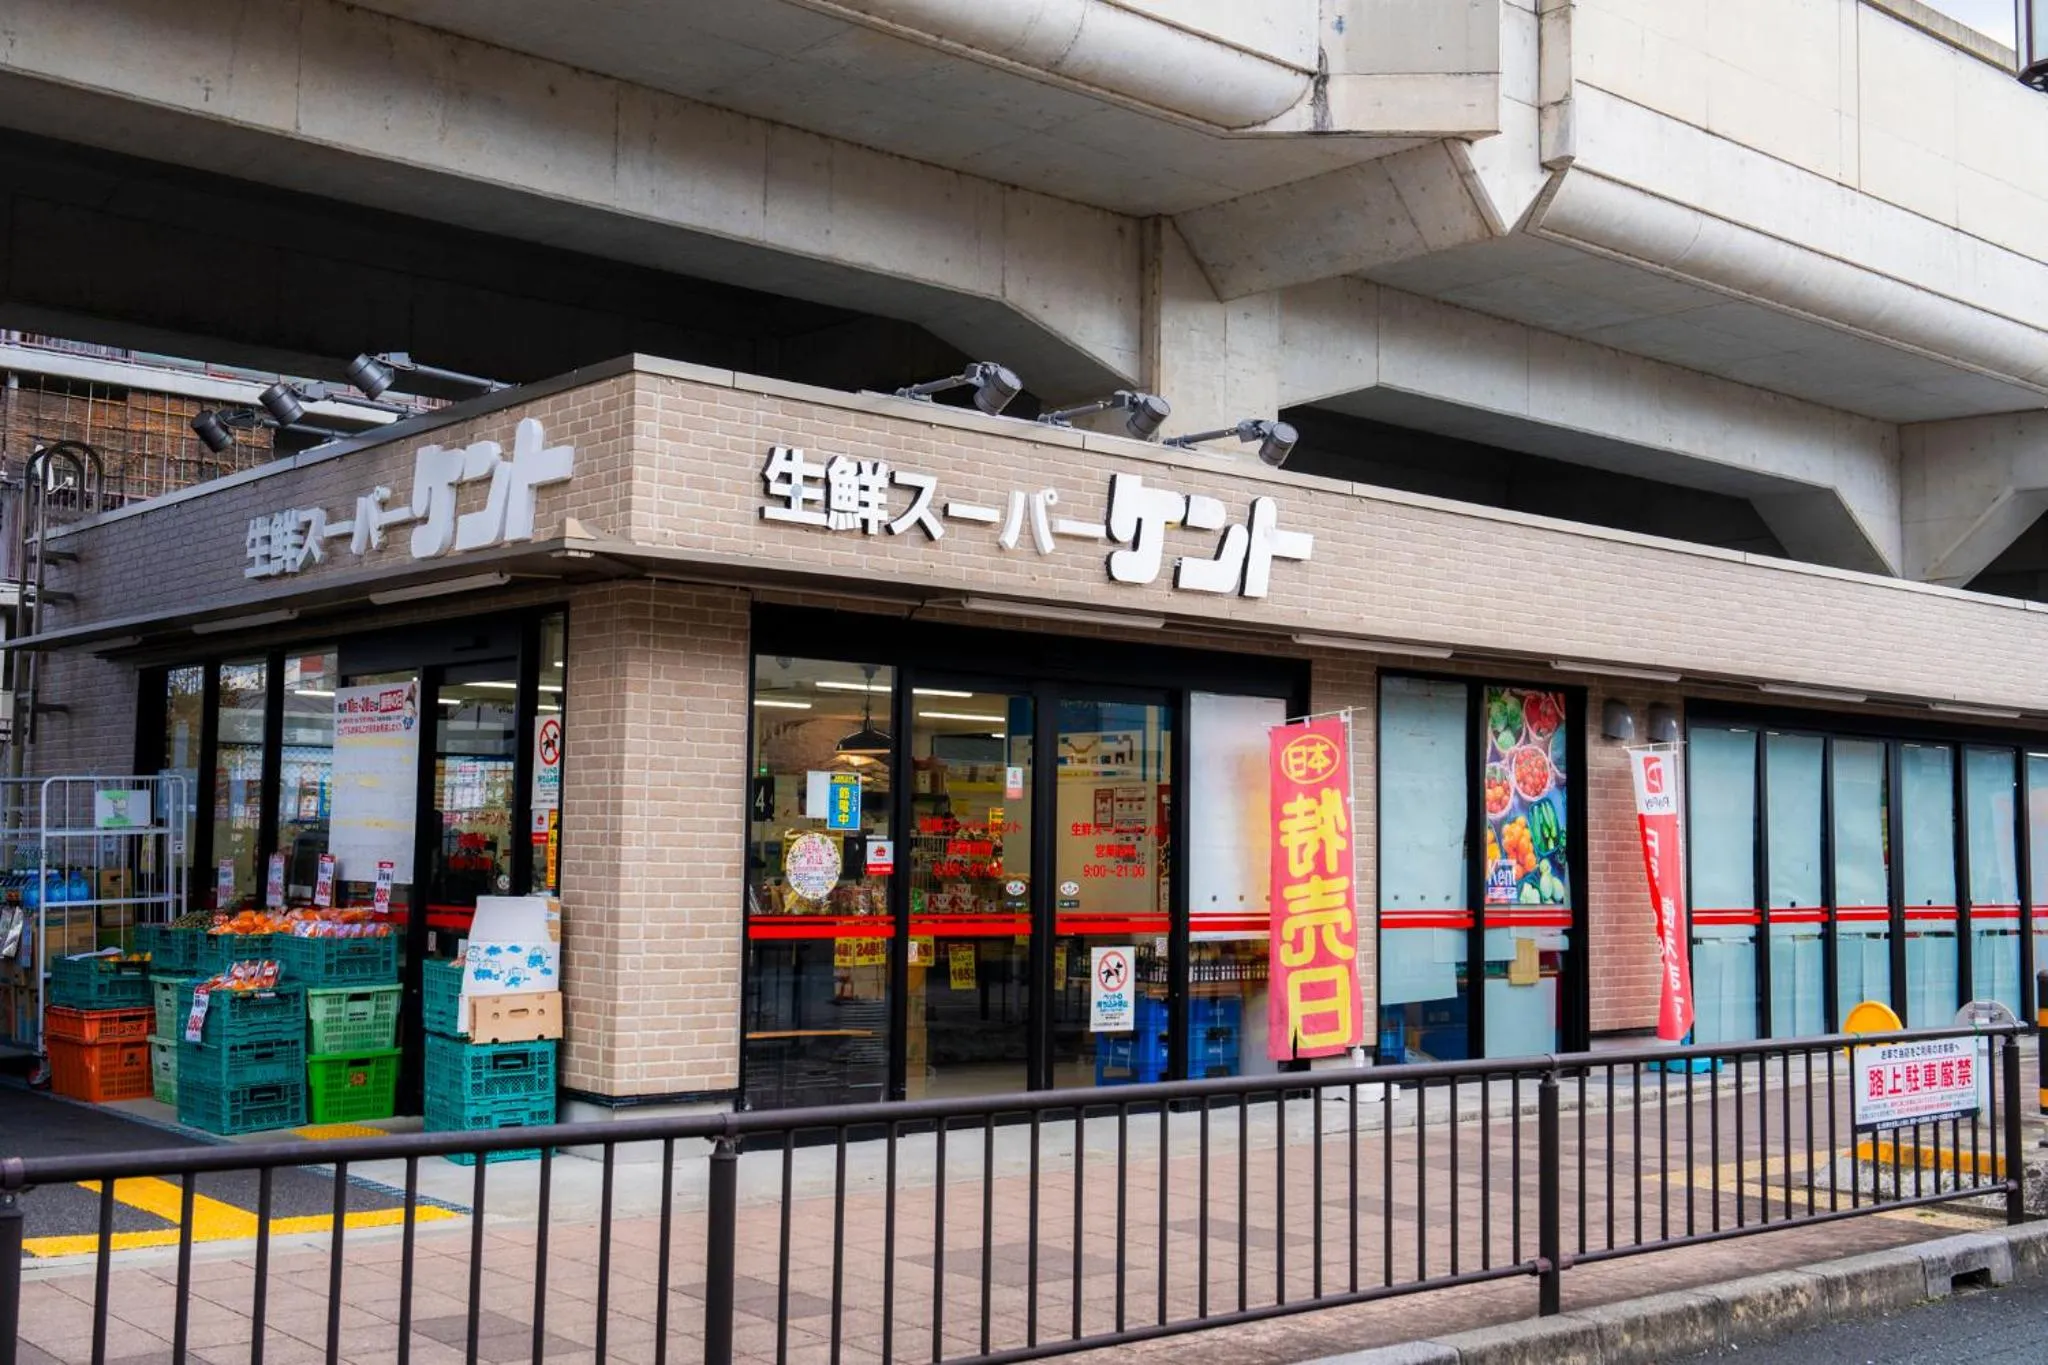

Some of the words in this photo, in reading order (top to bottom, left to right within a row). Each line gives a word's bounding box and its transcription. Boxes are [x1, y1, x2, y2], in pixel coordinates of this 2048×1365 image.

[244, 417, 574, 579] 生鮮スーパーケント
[759, 446, 1313, 598] 生鮮スーパーケント
[1869, 1058, 1972, 1097] 路上駐車厳禁
